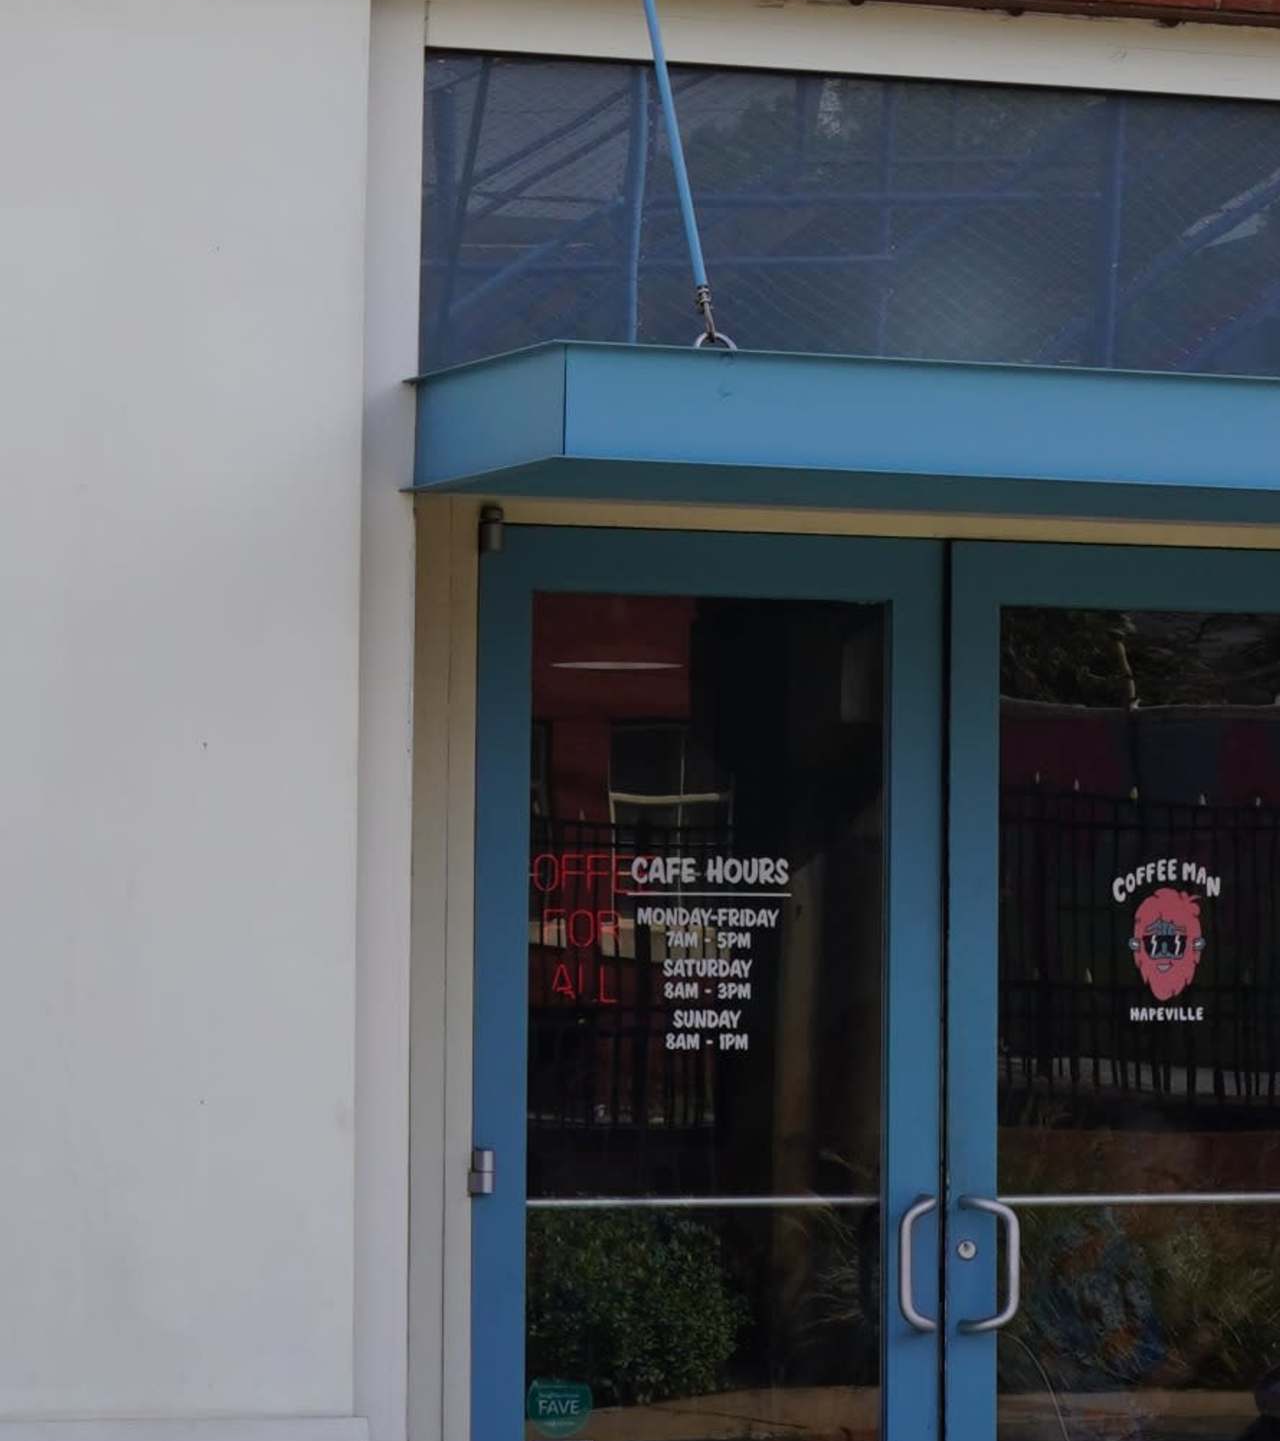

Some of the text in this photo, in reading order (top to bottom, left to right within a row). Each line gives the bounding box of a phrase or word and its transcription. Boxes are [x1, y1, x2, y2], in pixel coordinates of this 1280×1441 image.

[532, 853, 657, 895] OFFE
[630, 855, 790, 886] CAFE HOURS
[1111, 858, 1221, 903] COFFEE MAN
[636, 906, 780, 928] MONDAY-FRIDAY
[665, 930, 699, 949] 7AM
[716, 931, 751, 949] 5PM
[662, 957, 753, 979] SATURDAY
[664, 981, 699, 1000] 8AM
[717, 981, 752, 1000] 3PM
[672, 1009, 742, 1029] SUNDAY
[1129, 1006, 1205, 1022] HAPEVILLE
[665, 1032, 701, 1051] 8AM
[718, 1032, 749, 1051] 1PM
[539, 1400, 580, 1416] FAVE
